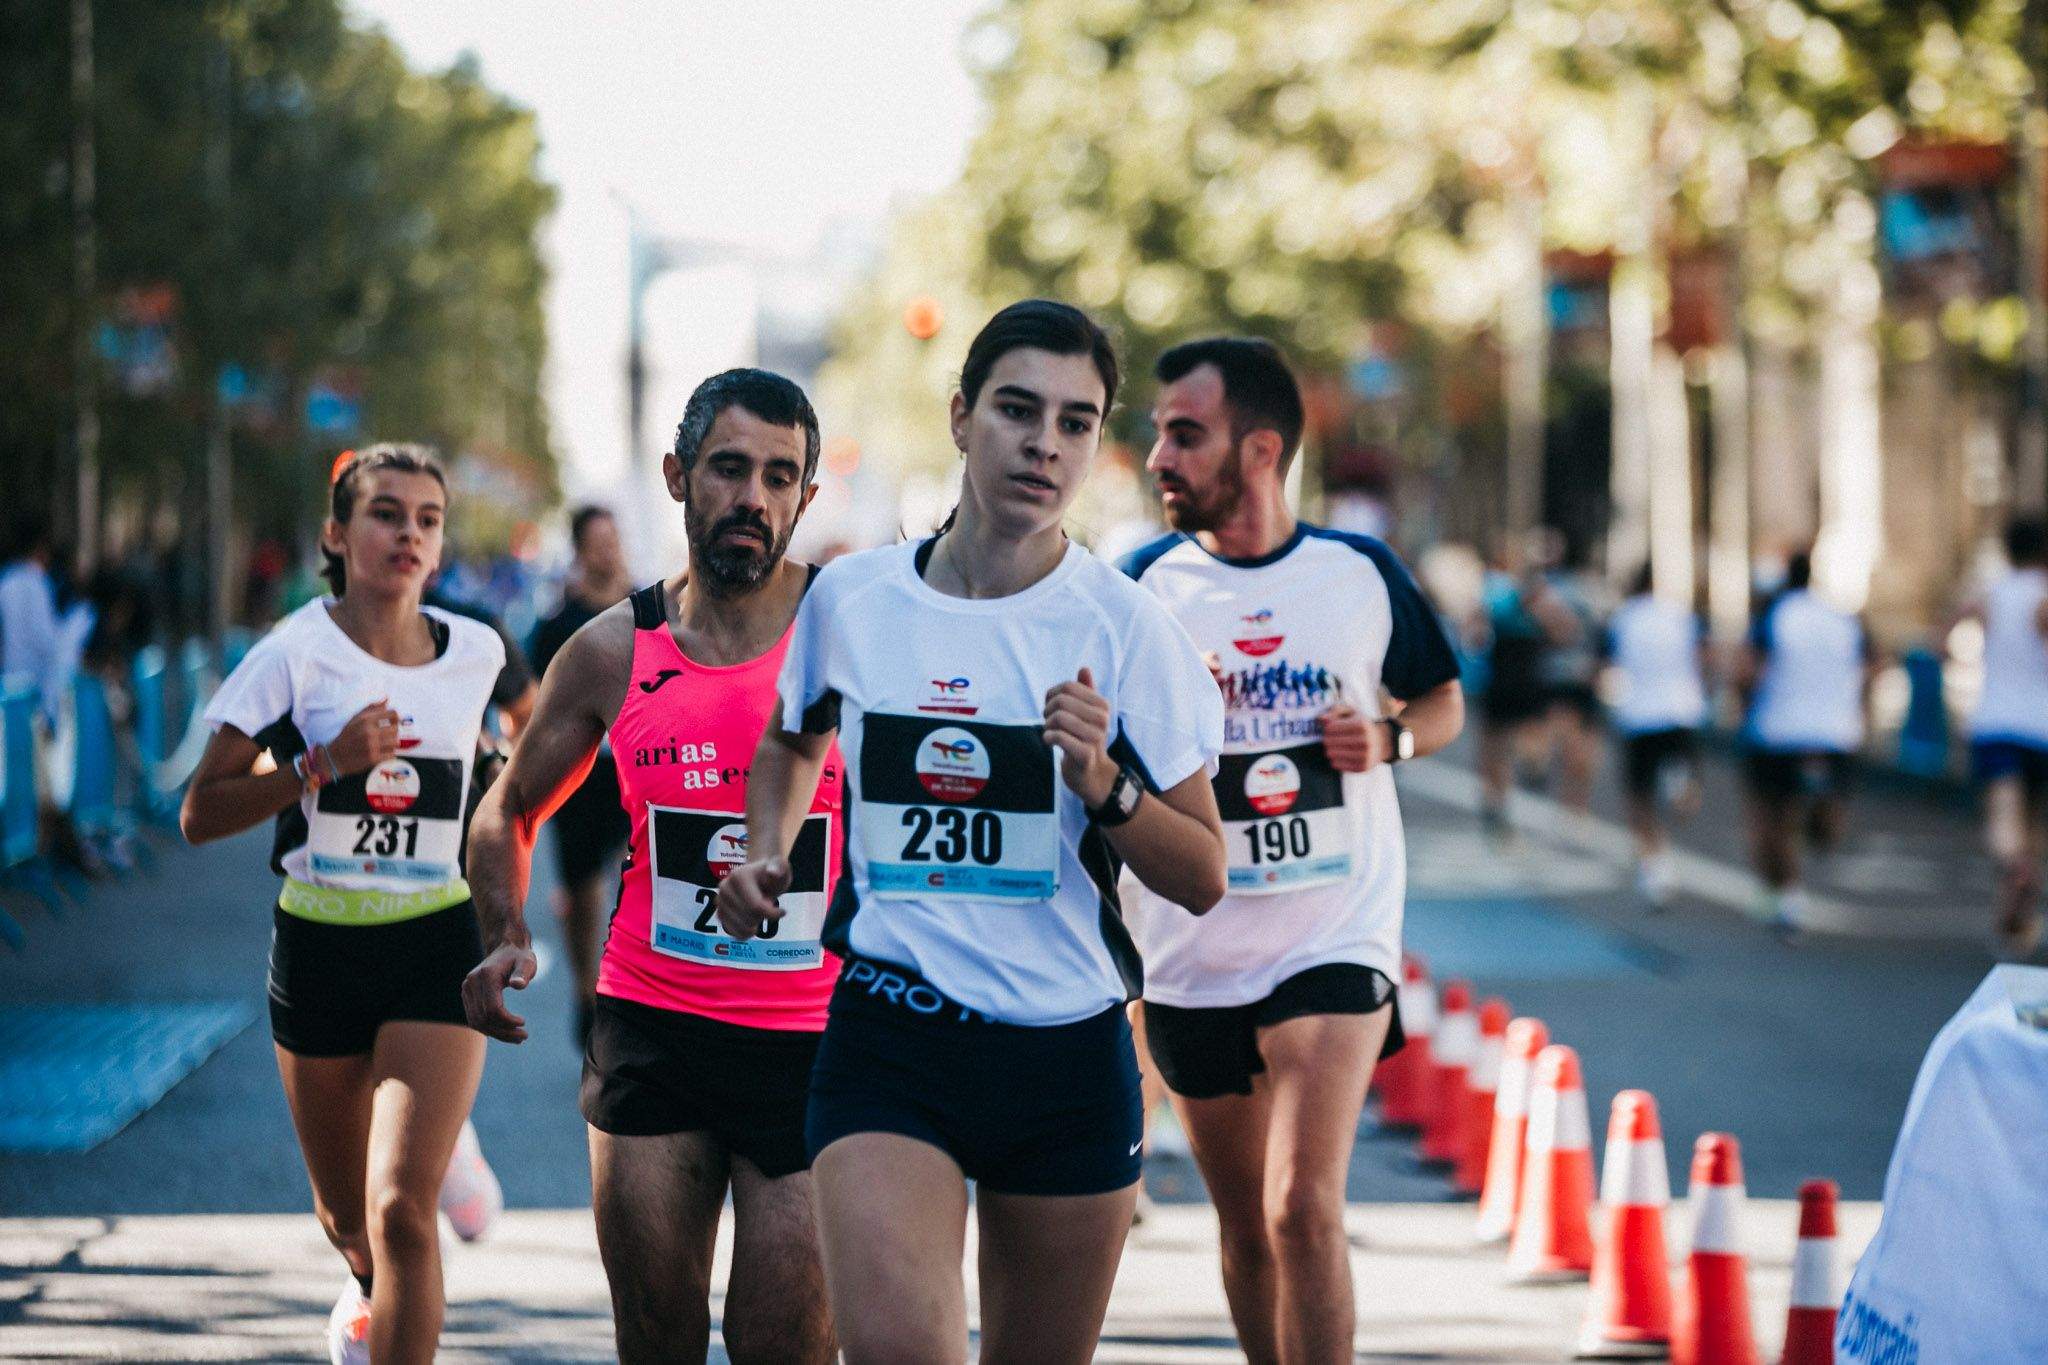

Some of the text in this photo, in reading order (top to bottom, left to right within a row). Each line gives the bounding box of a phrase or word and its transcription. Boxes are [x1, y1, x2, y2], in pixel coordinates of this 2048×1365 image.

[635, 736, 718, 768] arias
[683, 765, 836, 791] asess
[352, 815, 420, 859] 231
[901, 807, 1003, 866] 230
[1243, 816, 1311, 865] 190
[693, 888, 780, 940] 20
[671, 935, 706, 953] MADRID
[844, 959, 944, 1013] PRO
